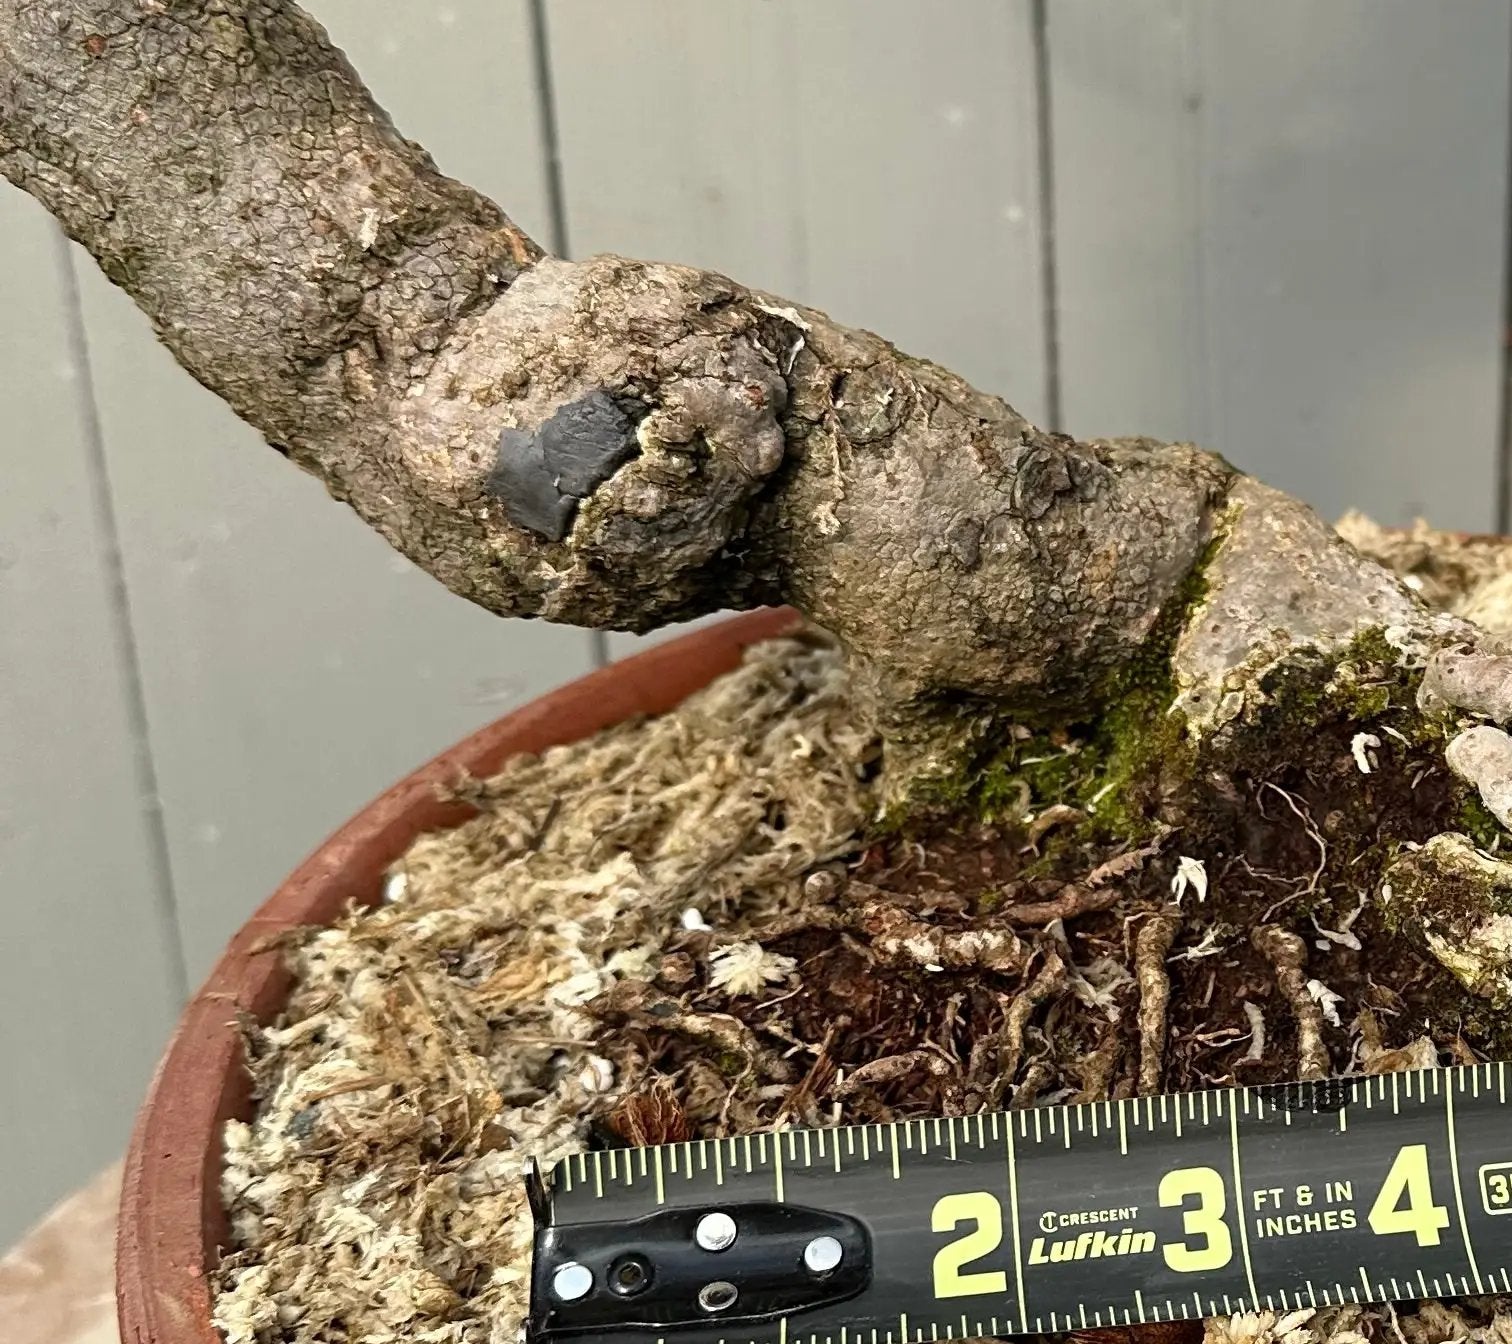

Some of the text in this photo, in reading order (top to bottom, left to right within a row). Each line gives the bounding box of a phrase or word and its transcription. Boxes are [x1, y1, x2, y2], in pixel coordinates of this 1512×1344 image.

[1253, 1180, 1353, 1211] FT & IN
[1367, 1144, 1449, 1247] 4
[1059, 1206, 1139, 1227] CRESCENT
[1158, 1167, 1233, 1273] 3
[1256, 1208, 1358, 1239] INCHES
[931, 1191, 1007, 1299] 2
[1027, 1227, 1157, 1265] Lufkin
